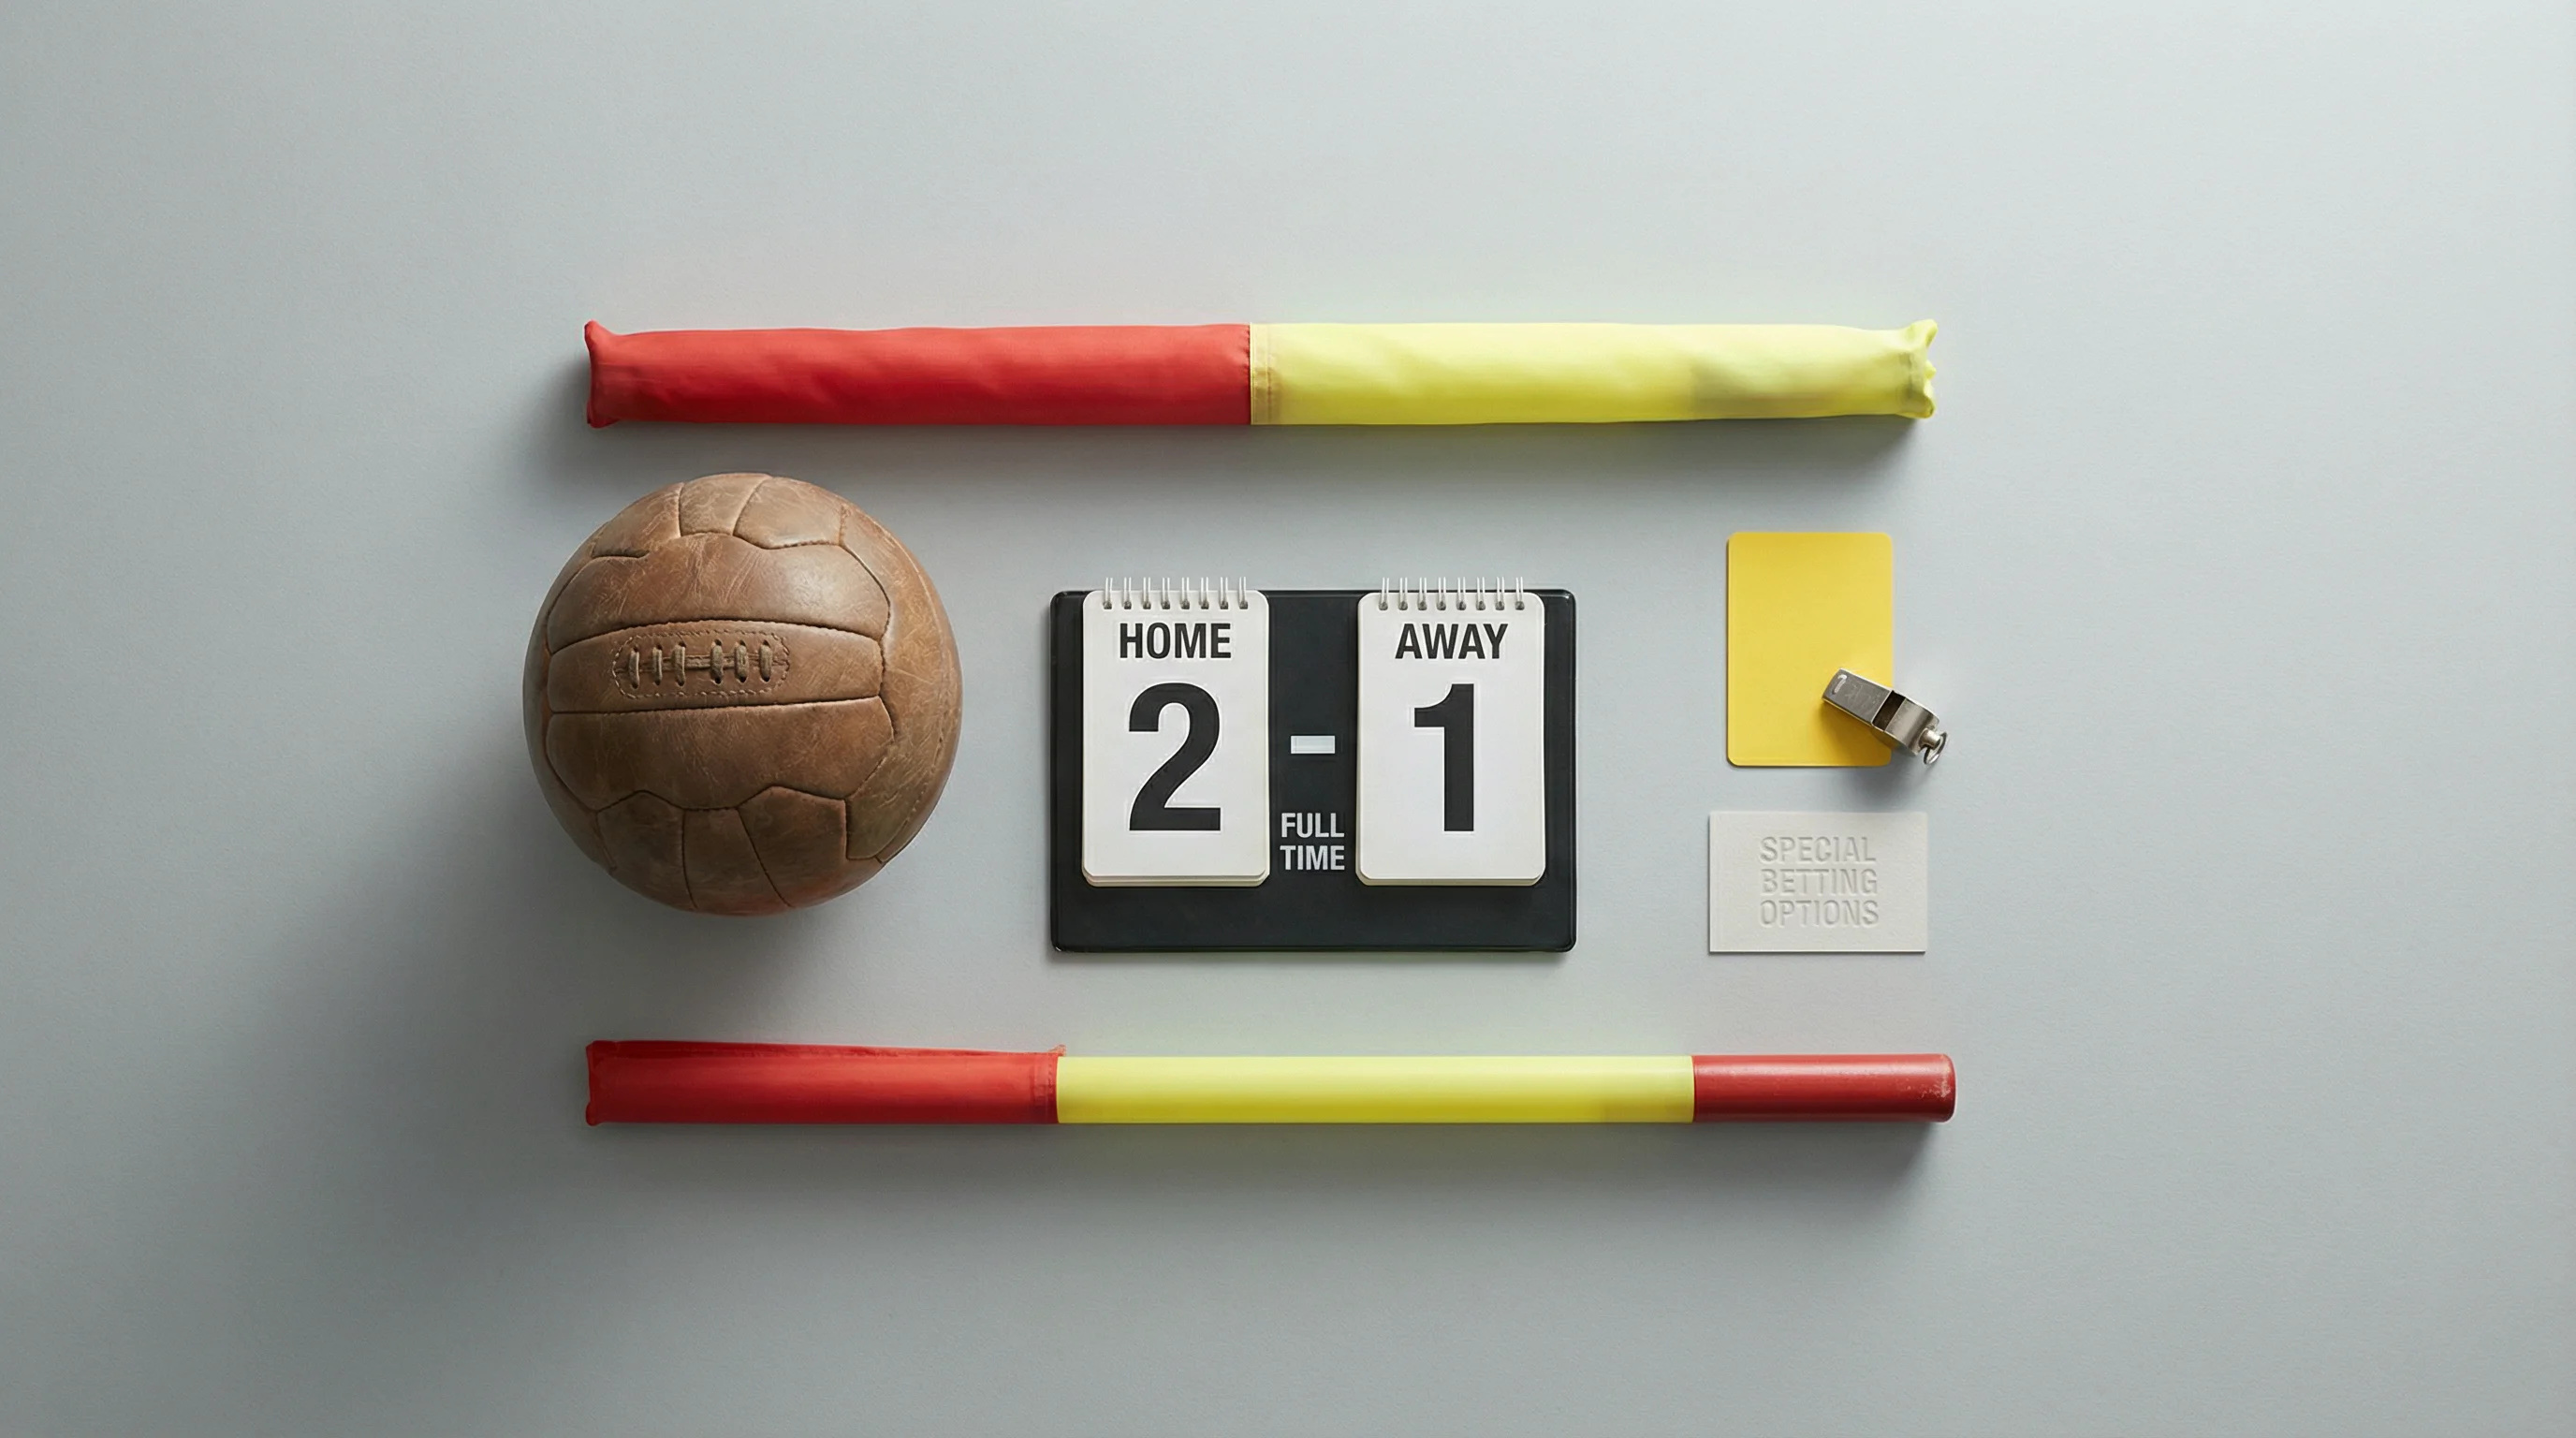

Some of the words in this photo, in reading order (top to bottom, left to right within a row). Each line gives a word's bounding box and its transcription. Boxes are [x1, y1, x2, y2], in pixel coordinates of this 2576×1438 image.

[1119, 622, 1232, 659] HOME
[1395, 623, 1509, 660] AWAY
[1128, 682, 1222, 831] 2
[1413, 682, 1474, 832] 1
[1281, 812, 1345, 839] FULL
[1279, 844, 1345, 871] TIME
[1759, 835, 1877, 863] SPECIAL
[1760, 867, 1878, 896] BETTING
[1759, 899, 1880, 927] OPTIONS
